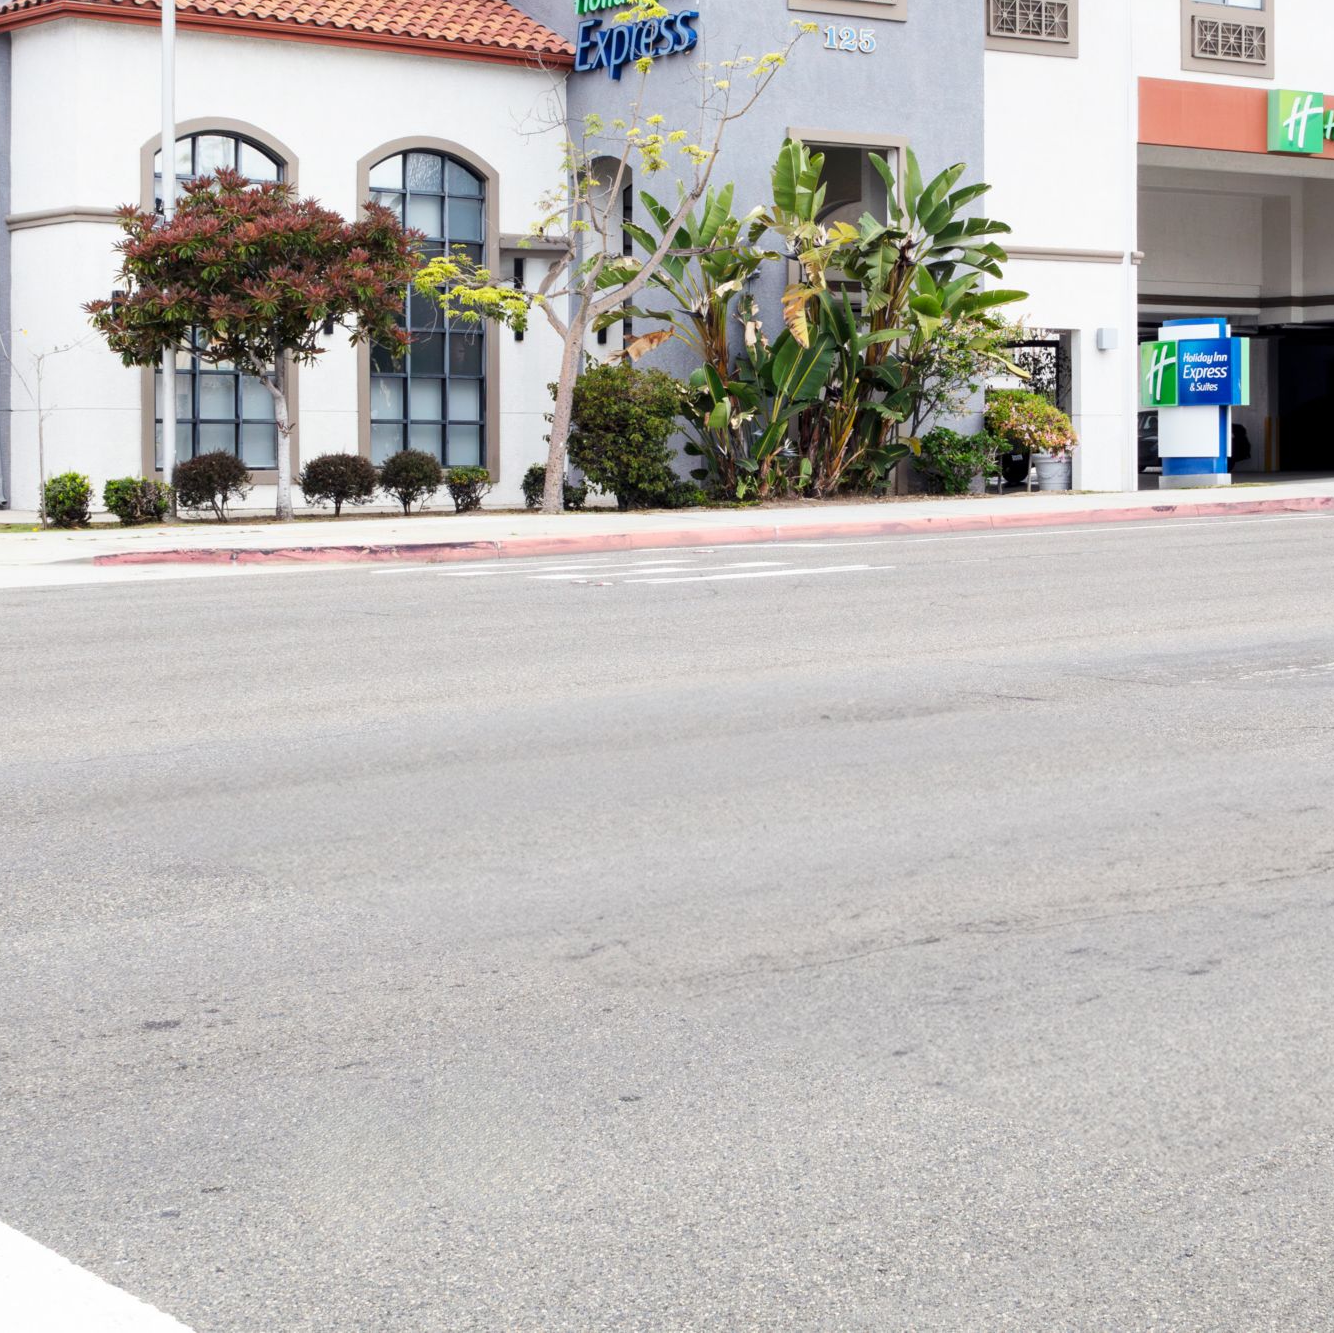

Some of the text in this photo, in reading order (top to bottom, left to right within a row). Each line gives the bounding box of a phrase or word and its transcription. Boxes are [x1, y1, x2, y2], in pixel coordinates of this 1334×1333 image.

[575, 12, 699, 81] Express
[823, 26, 877, 53] 125
[1183, 352, 1228, 364] Holiday Inn
[1183, 365, 1228, 382] Express
[1190, 383, 1218, 392] & Suites
